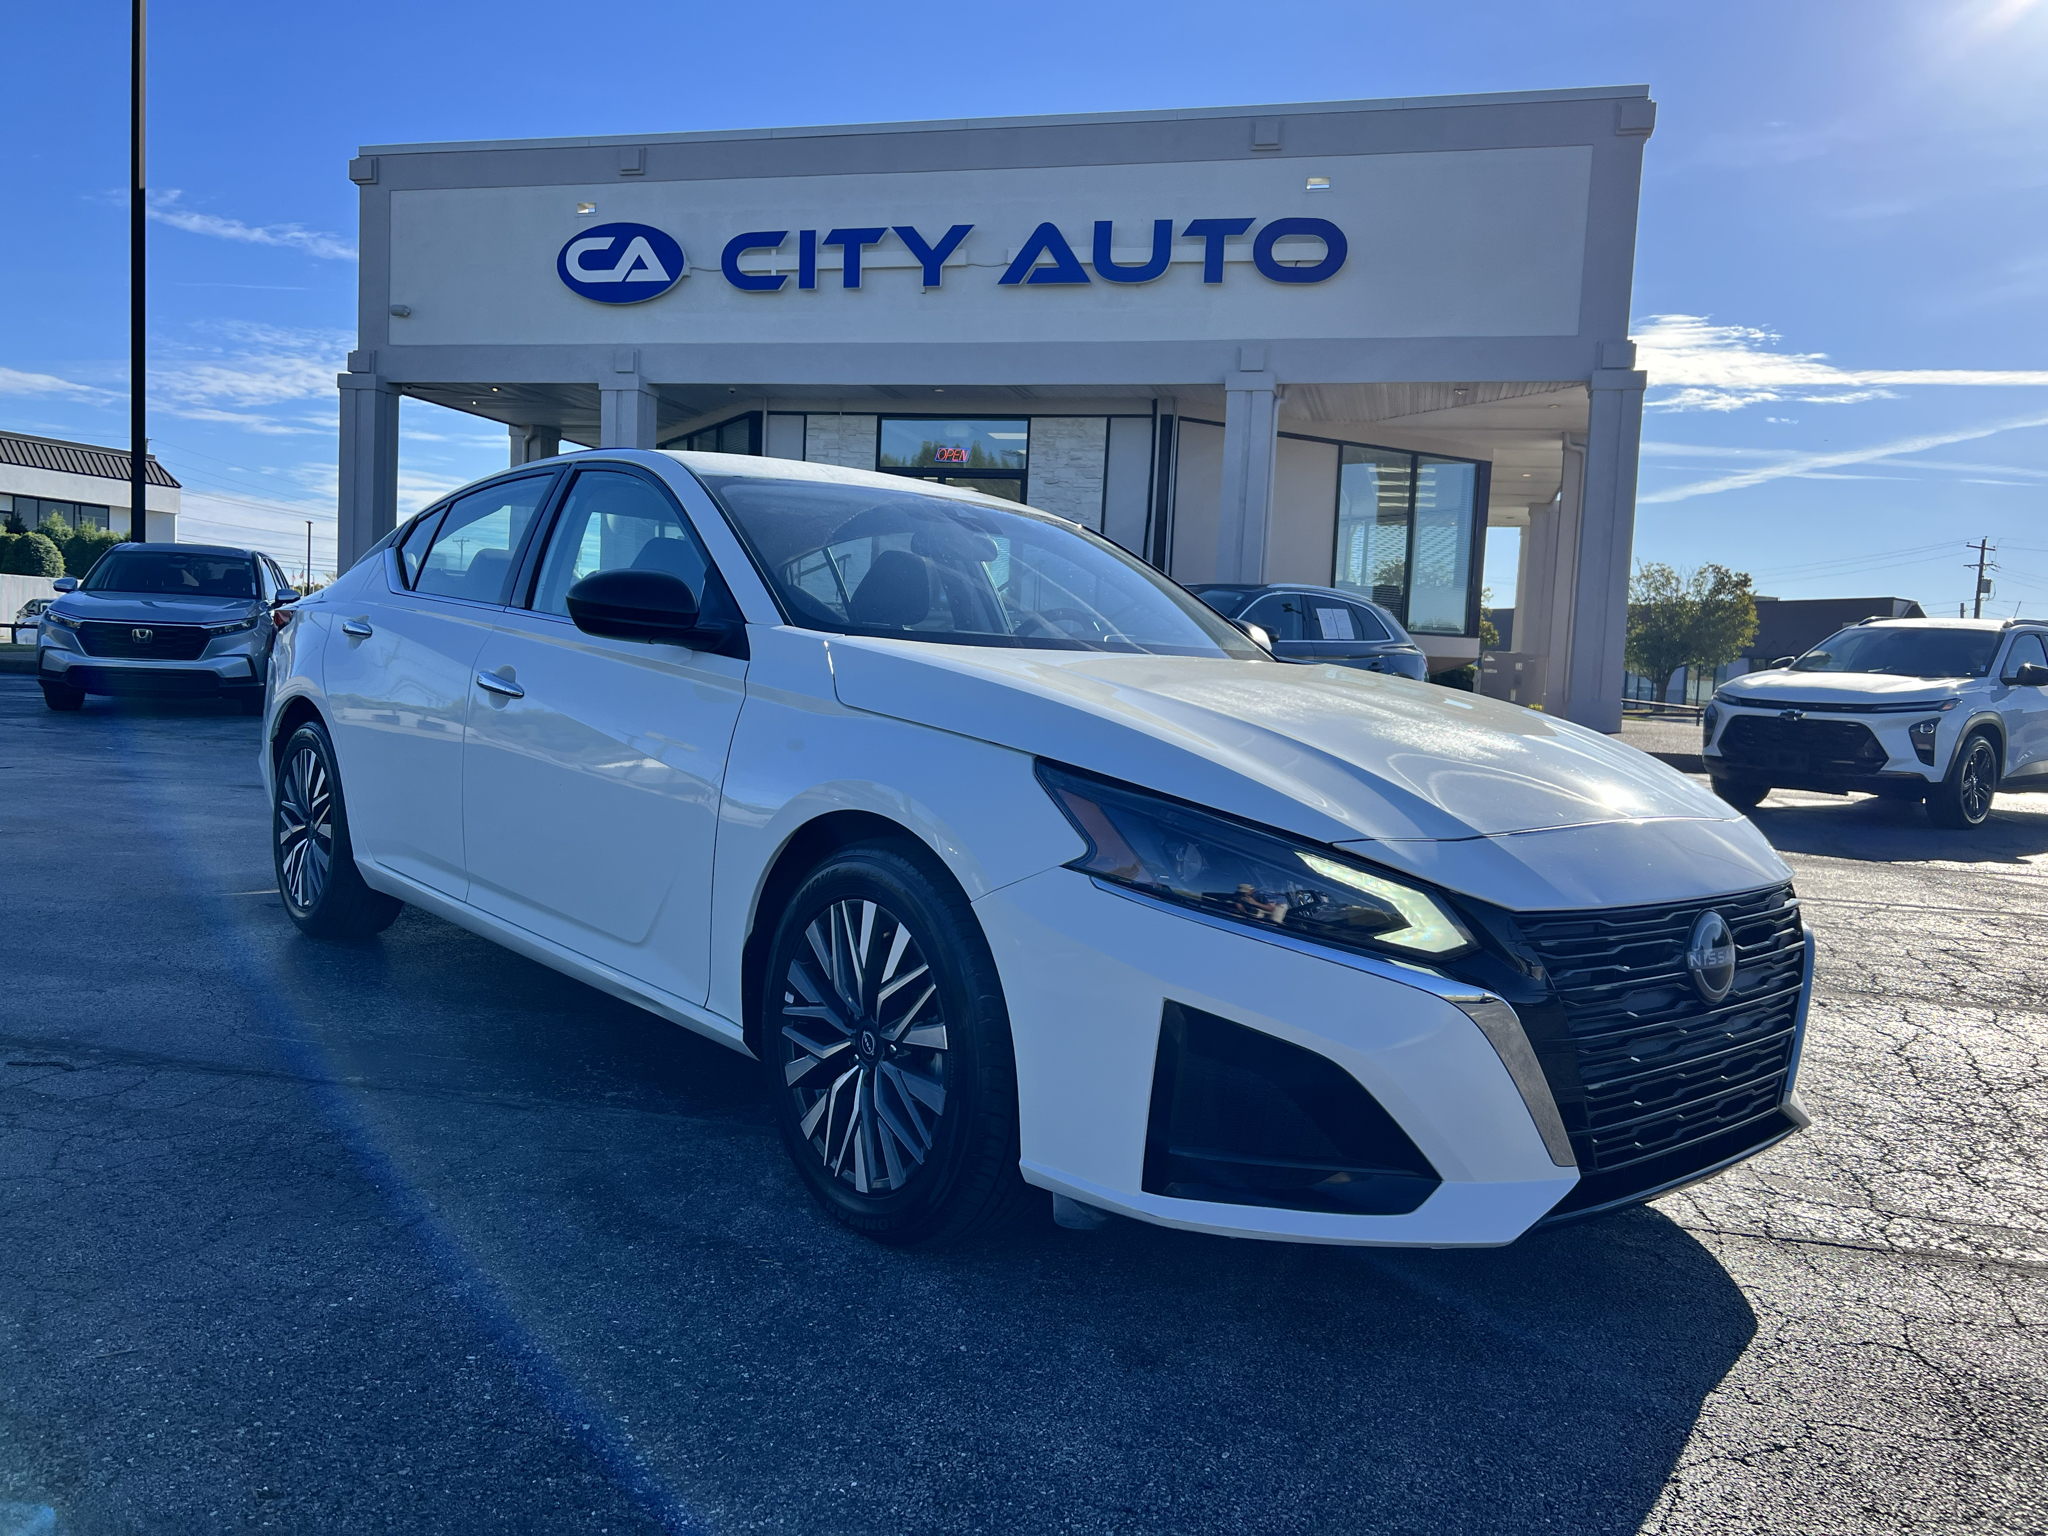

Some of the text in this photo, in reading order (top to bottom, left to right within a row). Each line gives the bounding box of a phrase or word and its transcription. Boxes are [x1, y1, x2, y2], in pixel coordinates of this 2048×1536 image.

[565, 236, 671, 283] CA
[720, 217, 1348, 292] CITY AUTO
[937, 448, 969, 462] OPEN
[1689, 949, 1734, 967] NISSA
